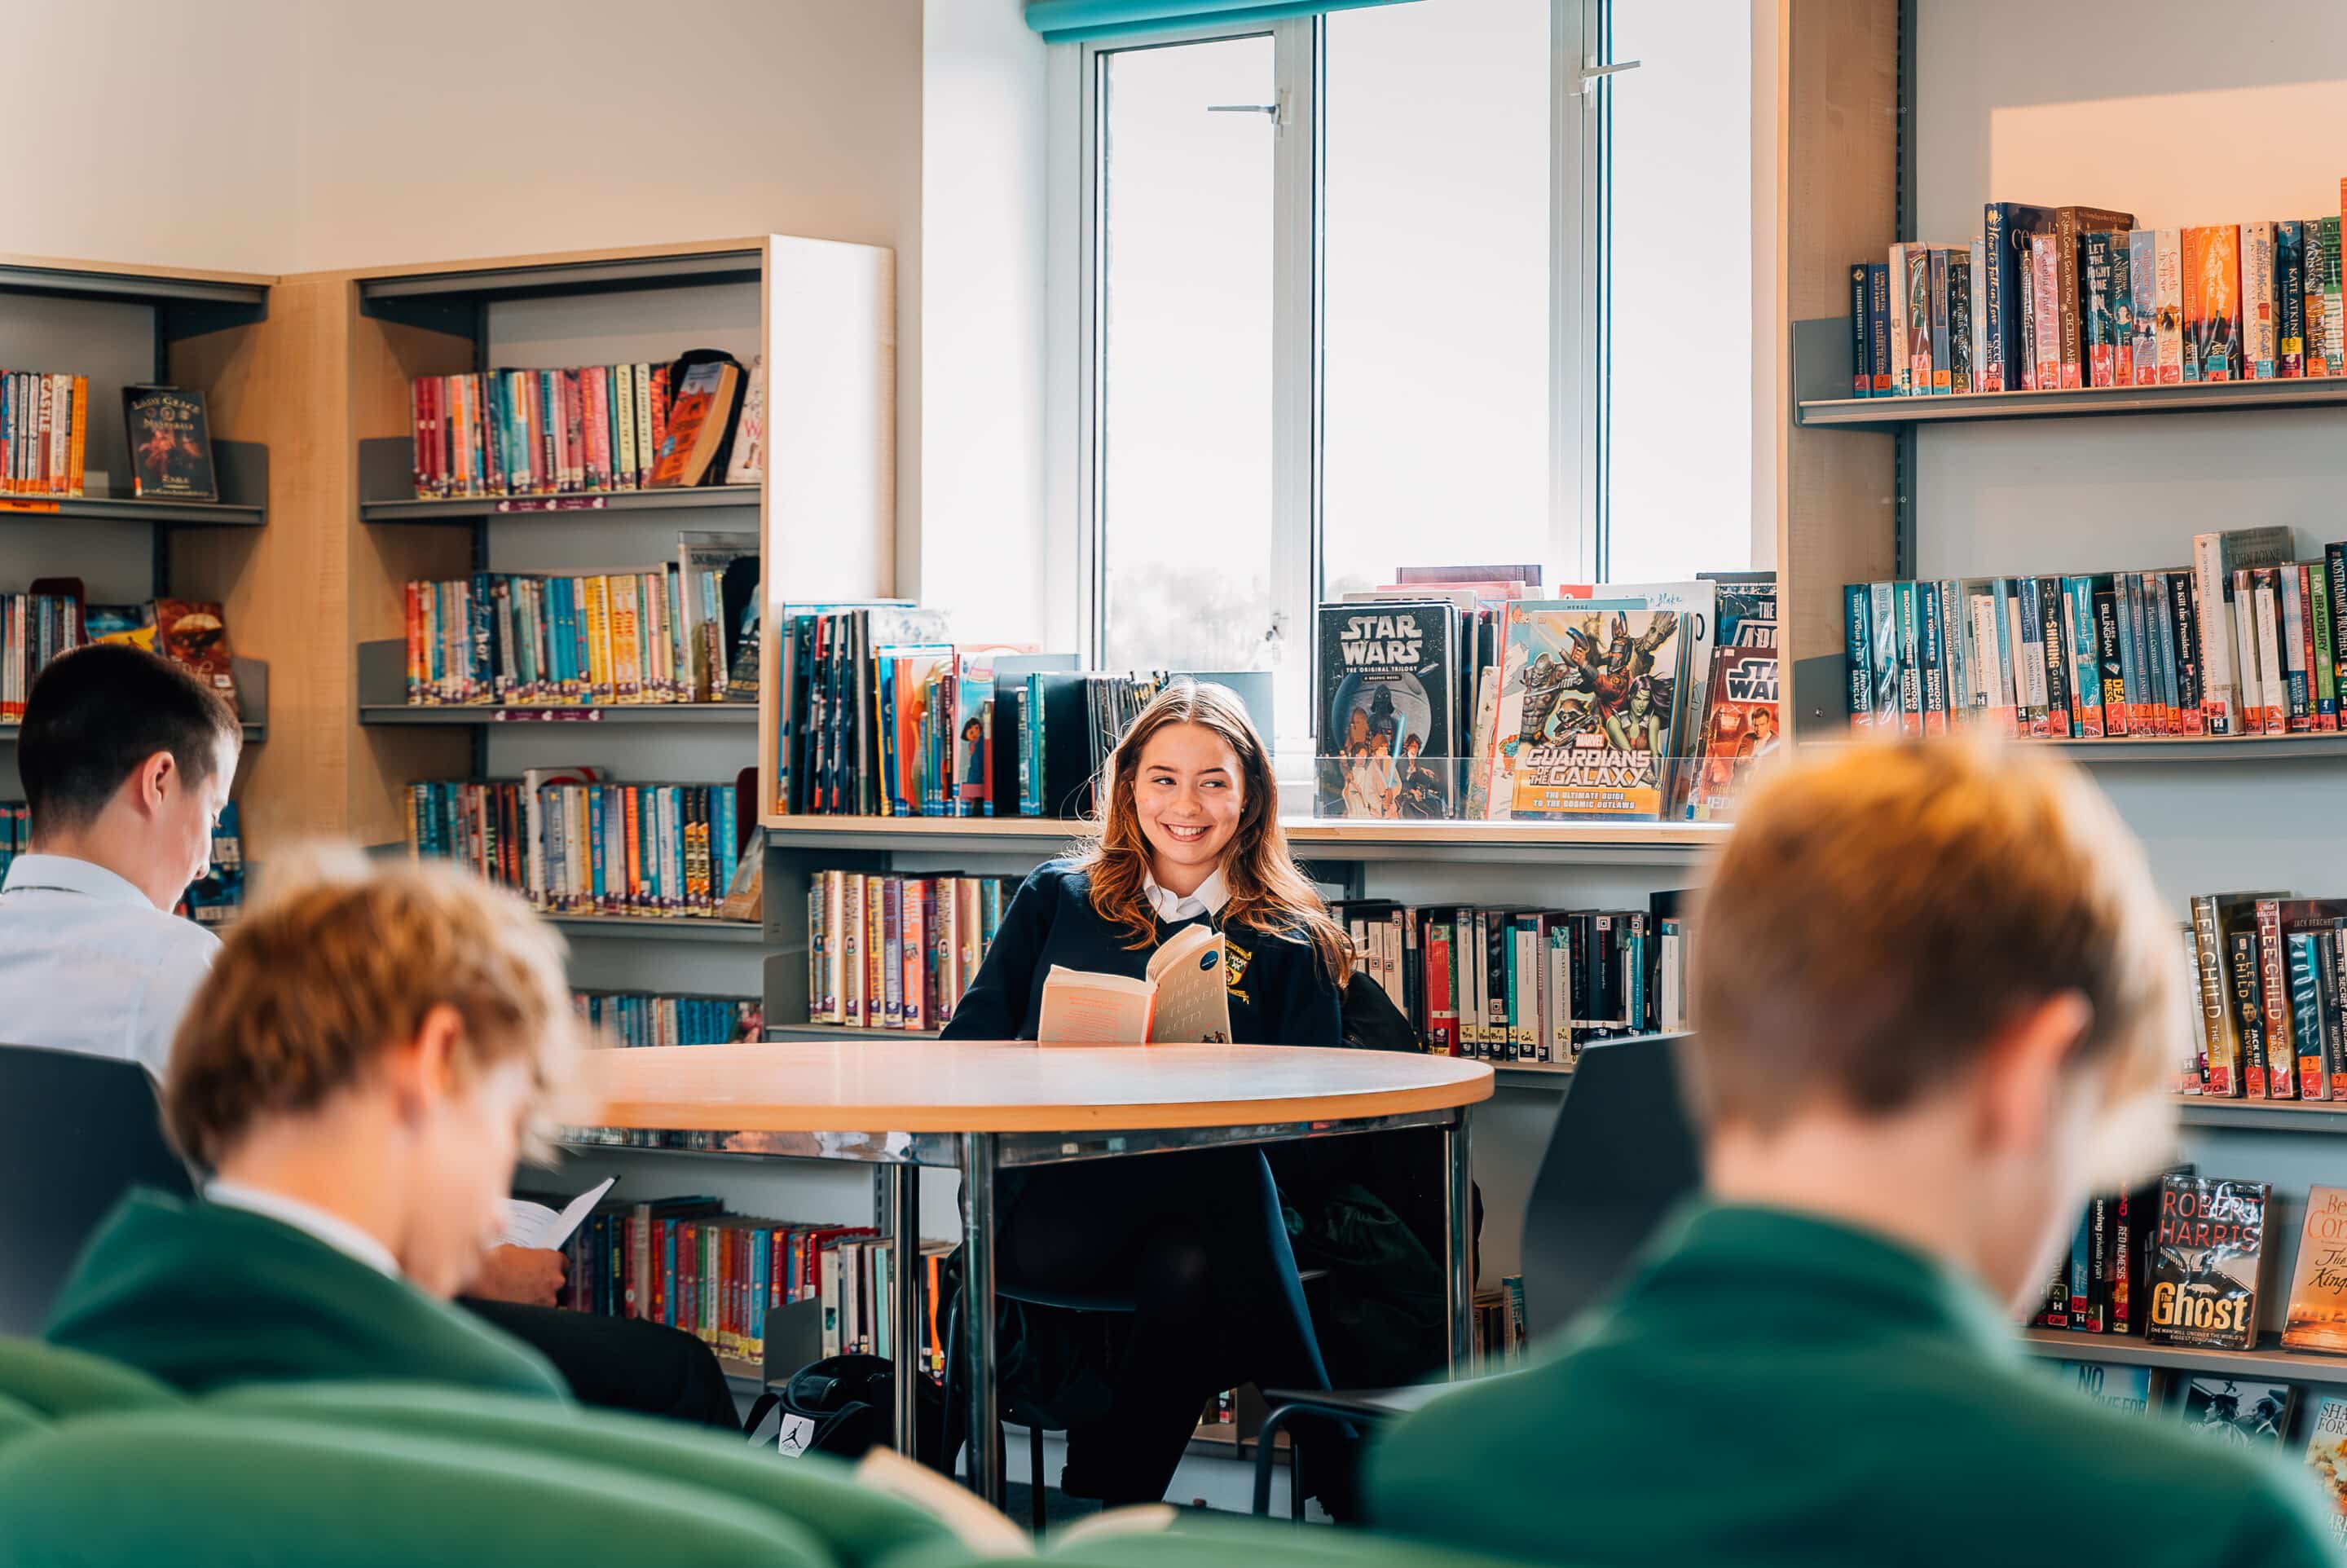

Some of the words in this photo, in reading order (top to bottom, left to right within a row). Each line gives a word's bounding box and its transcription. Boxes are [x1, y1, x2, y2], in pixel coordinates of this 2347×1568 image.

[1988, 226, 1999, 250] How
[2063, 237, 2072, 259] Could
[2089, 244, 2105, 254] LET
[1988, 253, 1998, 262] to
[2064, 261, 2072, 274] See
[2089, 255, 2105, 265] THE
[2307, 239, 2316, 292] ATKINSON
[1988, 266, 1998, 286] Fall
[2064, 275, 2072, 286] Me
[2113, 254, 2124, 300] ANDREWS
[2169, 251, 2178, 292] Cometh
[2288, 267, 2298, 293] KATE
[2089, 280, 2107, 292] ONE
[2257, 274, 2267, 301] World
[1988, 302, 2001, 326] Love
[2290, 297, 2299, 337] ATKINS
[1875, 320, 1884, 355] ELIZABETH
[2065, 313, 2074, 346] CECELIA
[39, 378, 52, 433] CASTLE
[2177, 580, 2184, 590] To
[2313, 575, 2322, 594] RAY
[2332, 558, 2346, 614] NOSTRADAMUS
[1759, 601, 1775, 619] THE
[2177, 592, 2186, 606] Kill
[2179, 608, 2187, 620] the
[2315, 595, 2327, 651] BRADBURY
[1340, 615, 1422, 640] STAR
[2102, 603, 2112, 657] BILLINGHAM
[2147, 606, 2155, 632] Plotted
[2151, 640, 2159, 674] Cornwall
[2180, 623, 2190, 658] President
[1341, 641, 1422, 665] WARS
[2046, 622, 2059, 668] SHINING
[2164, 640, 2172, 674] Cornwall
[2138, 644, 2146, 676] Cornwall
[1576, 734, 1604, 747] MARVEL
[1526, 748, 1651, 767] GUARDIANS
[1538, 766, 1549, 775] OF
[1530, 774, 1548, 785] THE
[1548, 767, 1647, 786] GALAXY
[2195, 906, 2213, 946] LEE
[2262, 925, 2278, 959] LEE
[2202, 952, 2222, 1019] CHILD
[2235, 953, 2248, 998] CHILD
[2247, 962, 2256, 988] LEE
[2266, 963, 2282, 1020] CHILD
[2211, 1024, 2219, 1042] THE
[2331, 1026, 2340, 1059] MURDER
[2095, 1200, 2104, 1231] saving
[2163, 1191, 2260, 1222] ROBERT
[2095, 1233, 2104, 1259] private
[2117, 1226, 2127, 1243] RED
[2159, 1219, 2257, 1251] HARRIS
[2095, 1261, 2103, 1280] ryan
[2116, 1244, 2127, 1280] NEMESIS
[2152, 1282, 2248, 1332] Ghost
[2160, 1293, 2173, 1303] The
[2077, 1364, 2105, 1397] NO
